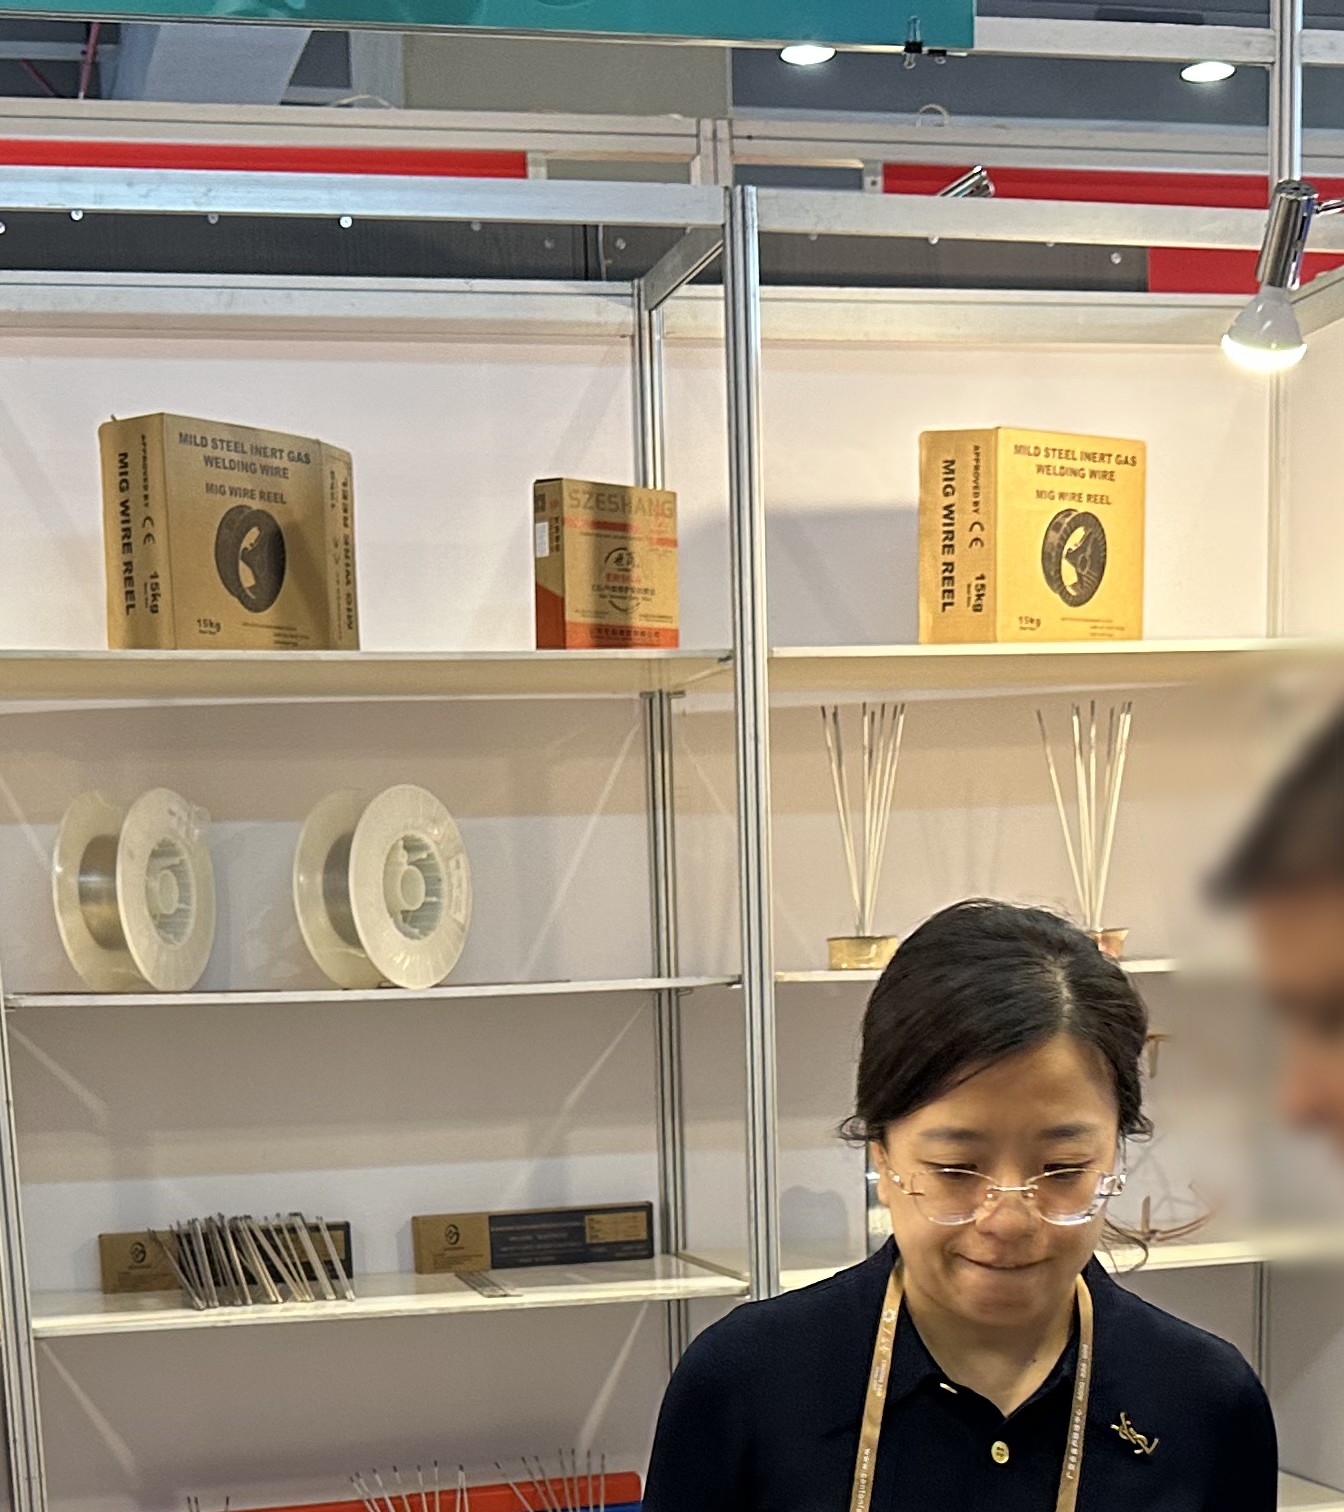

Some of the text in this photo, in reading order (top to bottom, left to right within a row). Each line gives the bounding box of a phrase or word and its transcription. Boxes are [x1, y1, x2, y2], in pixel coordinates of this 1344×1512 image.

[178, 432, 311, 464] MILD STEEL INERT GAS
[1014, 444, 1138, 468] MILD STEEL INERT GAS
[203, 455, 289, 480] WELDING WIRE
[972, 445, 981, 514] APPROVED BY
[1036, 464, 1116, 482] WELDING WIRE
[205, 482, 287, 504] MIG WIRE REEL
[568, 489, 674, 518] SZESHANG
[1036, 489, 1112, 505] MIG WIRE REEL
[118, 452, 136, 616] MIG WIRE REEL
[941, 459, 955, 613] MIG WIRE REEL
[972, 573, 986, 613] 15kg
[196, 617, 222, 632] 15kg
